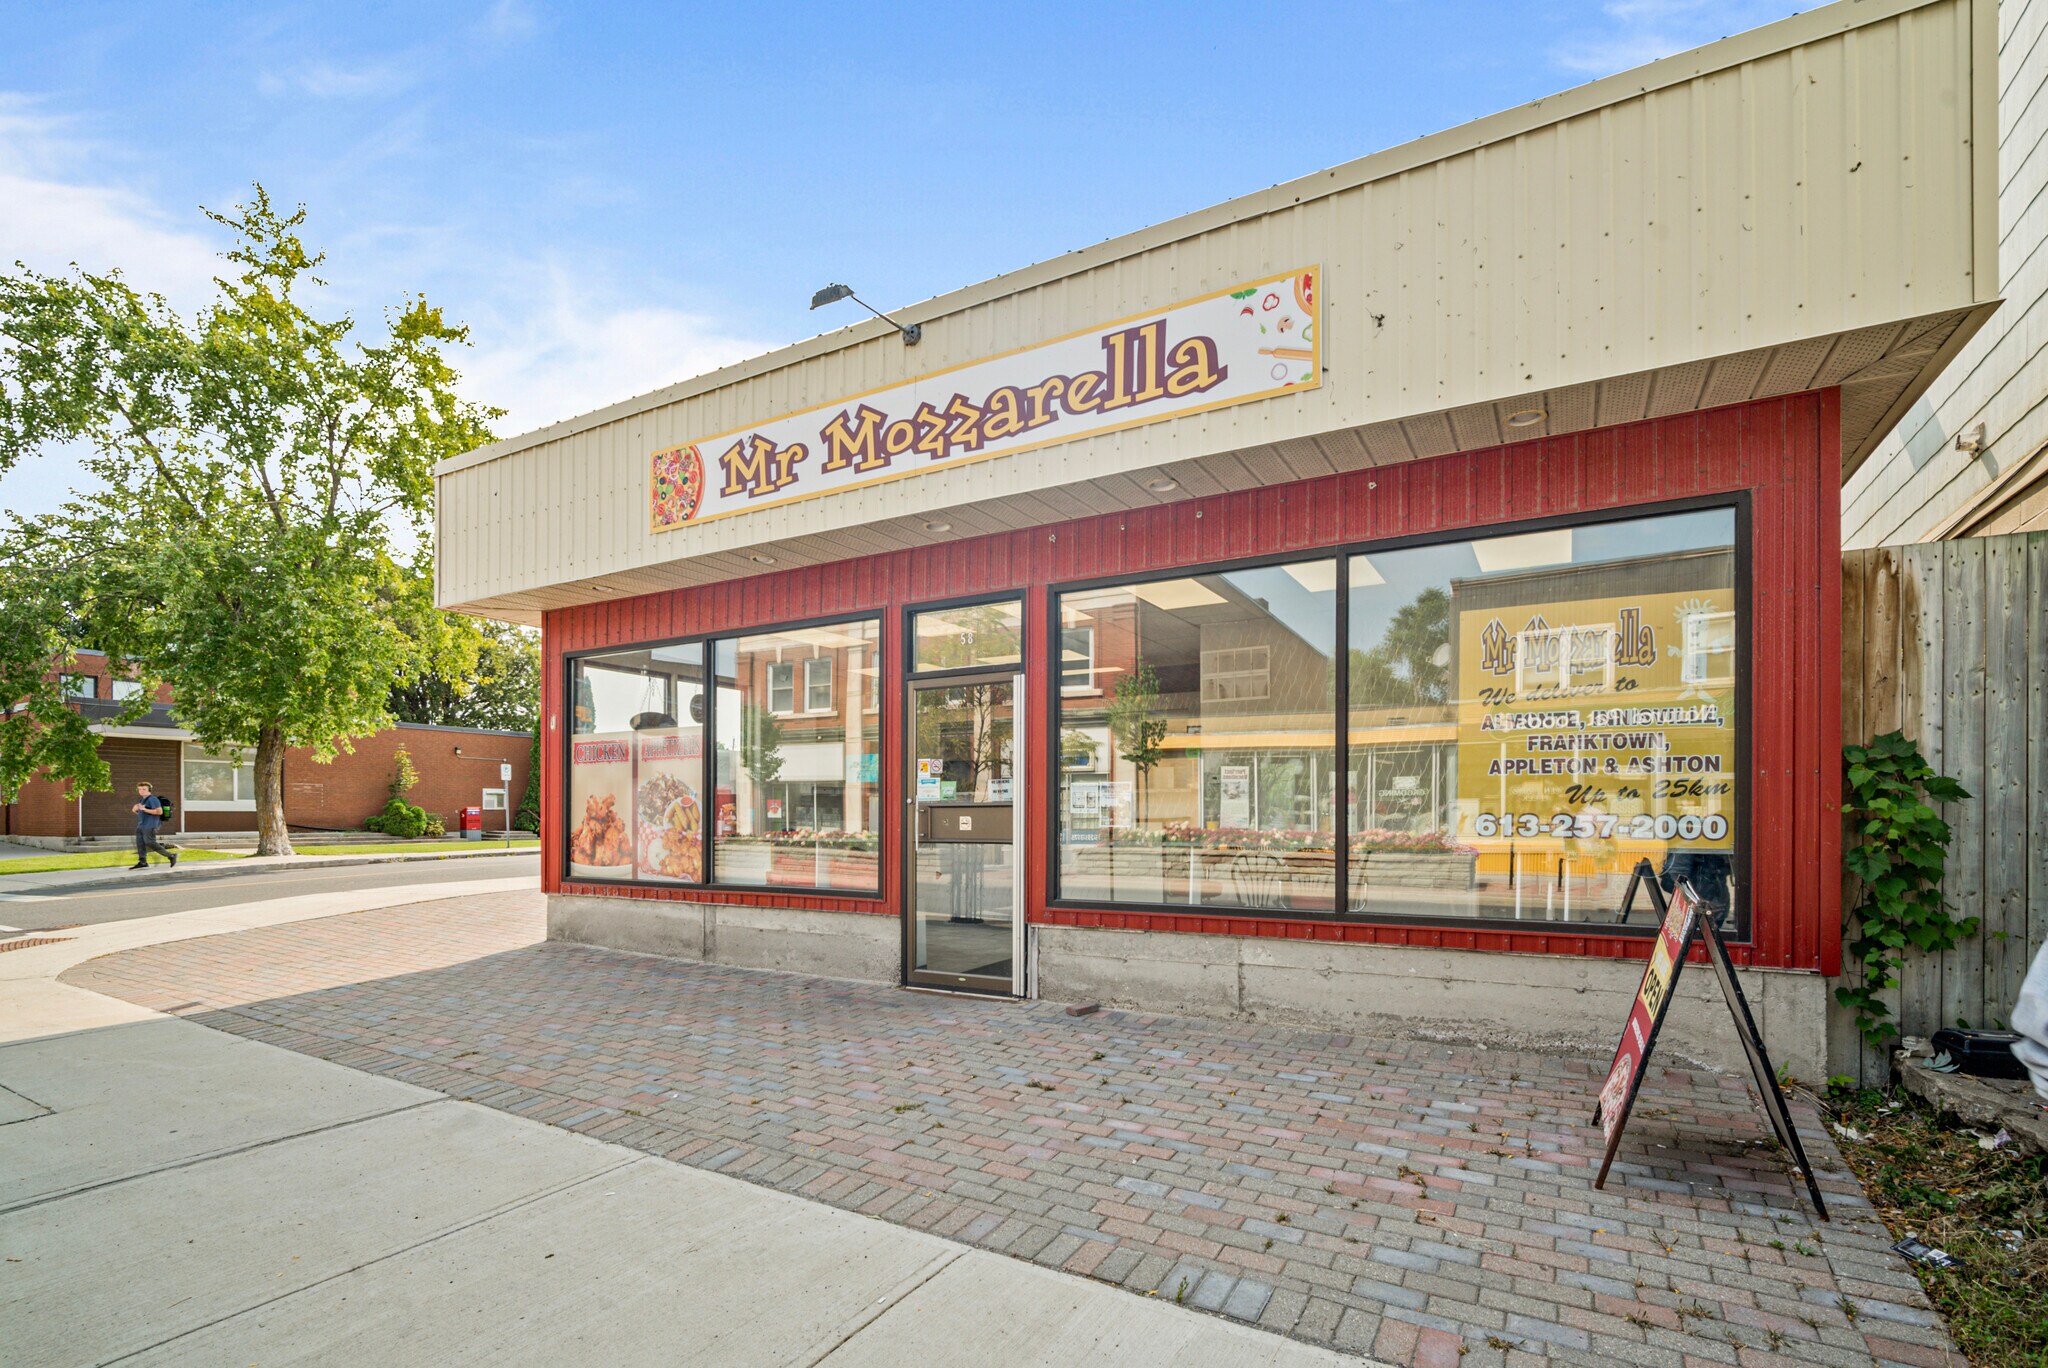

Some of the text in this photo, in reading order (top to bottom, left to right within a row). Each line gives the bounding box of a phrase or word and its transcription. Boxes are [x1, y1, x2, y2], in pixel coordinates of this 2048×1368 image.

[720, 317, 1229, 499] Mr Mozzarella
[960, 632, 974, 645] 58
[1480, 606, 1658, 676] Mr Mozzarella
[1478, 676, 1640, 706] We deliver to
[576, 743, 626, 762] CHICKEN
[644, 737, 701, 757] APPETIZERS
[1527, 731, 1670, 753] FRANKTOWN,
[1488, 754, 1722, 776] APPLETON & ASHTON
[1565, 783, 1607, 806] Up
[1617, 785, 1641, 800] to
[1652, 776, 1731, 799] 25km
[1474, 811, 1729, 841] 613-257-2000
[1643, 967, 1664, 1017] OPEN
